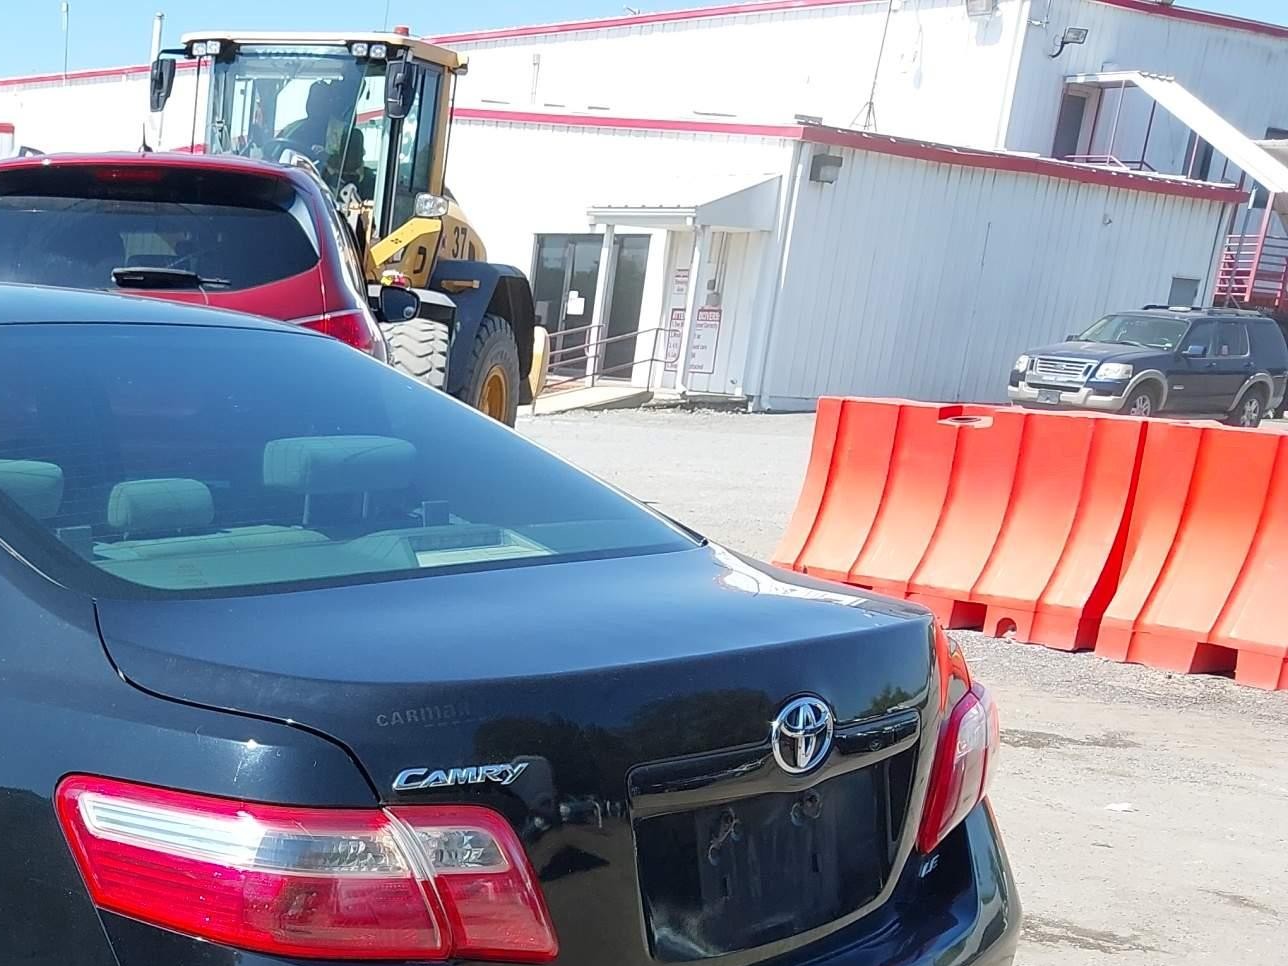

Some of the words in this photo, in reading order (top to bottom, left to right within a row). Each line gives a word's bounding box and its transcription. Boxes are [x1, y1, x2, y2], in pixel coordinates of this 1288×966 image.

[452, 226, 467, 259] 37
[391, 762, 530, 791] CAMRY
[918, 854, 940, 877] LE
